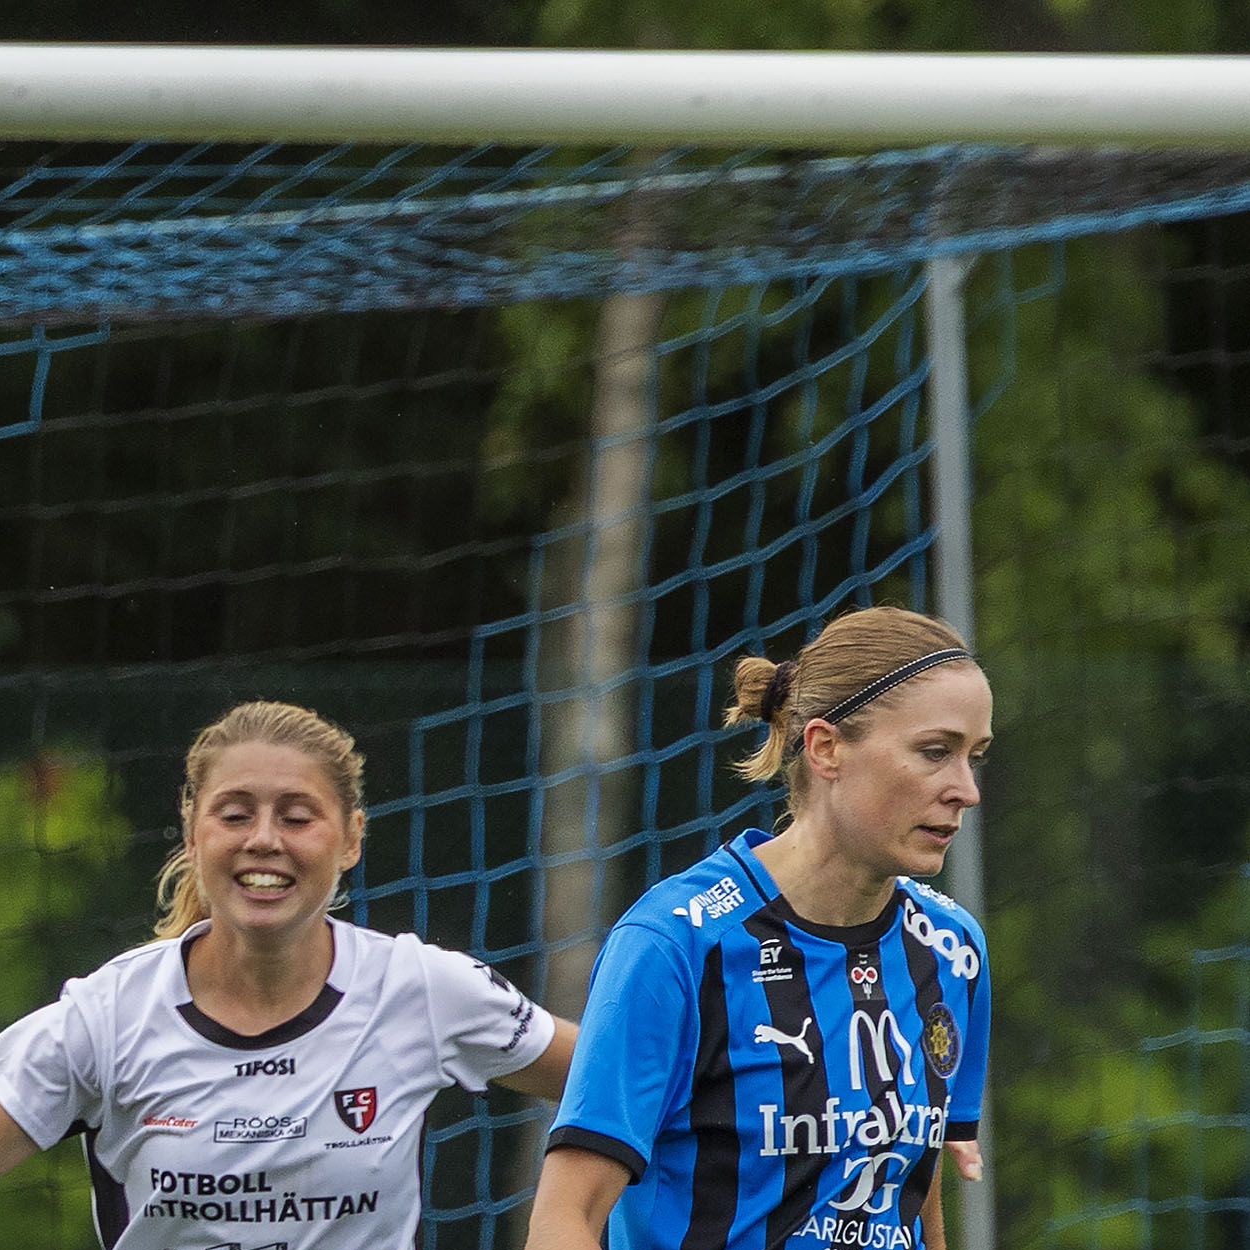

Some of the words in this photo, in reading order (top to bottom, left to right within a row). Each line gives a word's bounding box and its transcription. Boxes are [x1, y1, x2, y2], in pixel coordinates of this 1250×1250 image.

[694, 876, 738, 908] INTER
[706, 887, 745, 919] SPORT
[760, 946, 783, 965] EY
[234, 1057, 296, 1077] TIFOSI
[233, 1115, 292, 1129] RÖÖS
[759, 1090, 952, 1157] Infrakraf
[151, 1168, 272, 1196] FOTBOLL
